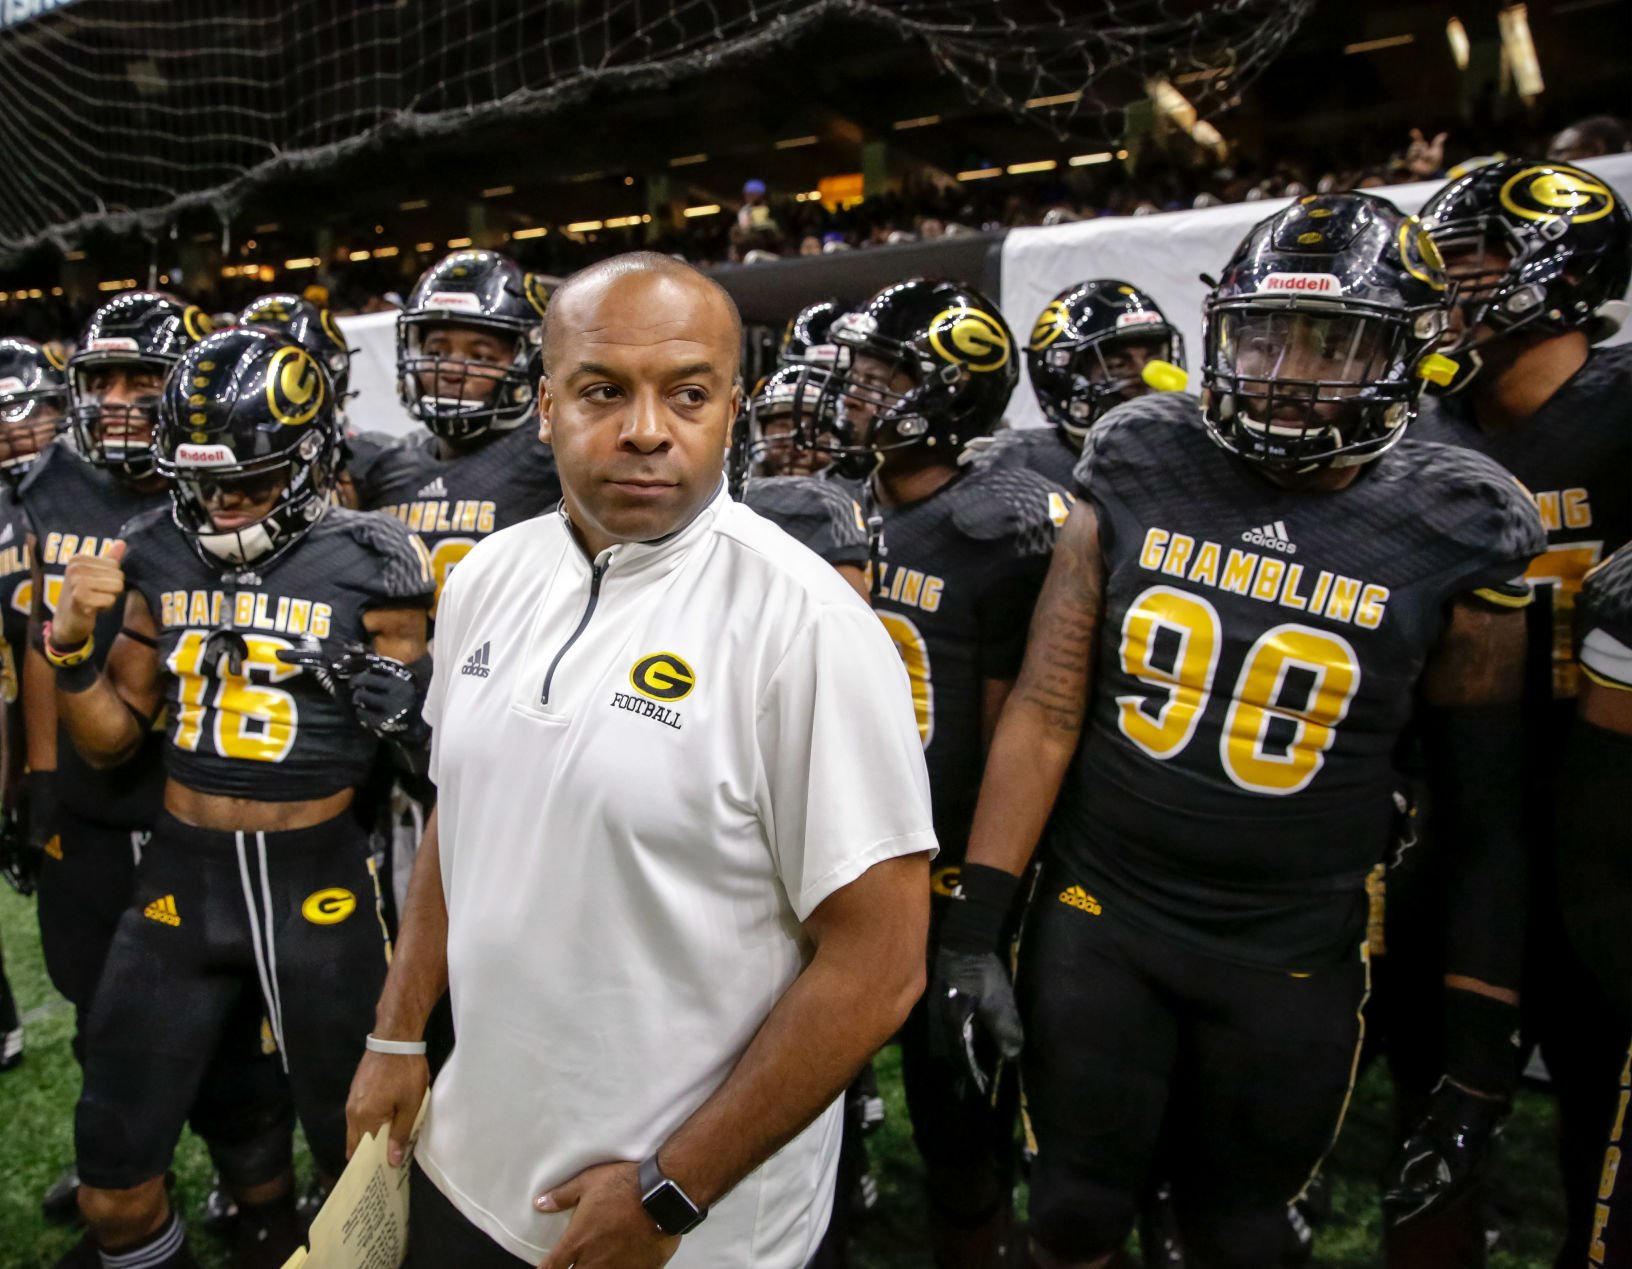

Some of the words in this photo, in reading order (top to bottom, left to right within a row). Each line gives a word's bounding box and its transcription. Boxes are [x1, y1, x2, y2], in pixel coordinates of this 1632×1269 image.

[1267, 277, 1331, 291] Riddell
[180, 449, 225, 462] Riddell
[1241, 531, 1297, 554] adidas
[1139, 527, 1390, 630] GRAMBLING
[461, 662, 490, 678] adidas
[629, 651, 696, 702] G
[166, 629, 304, 763] 16
[1115, 585, 1361, 796] 90
[610, 692, 682, 730] FOOTBALL
[302, 887, 357, 925] G
[1059, 891, 1102, 916] adidas
